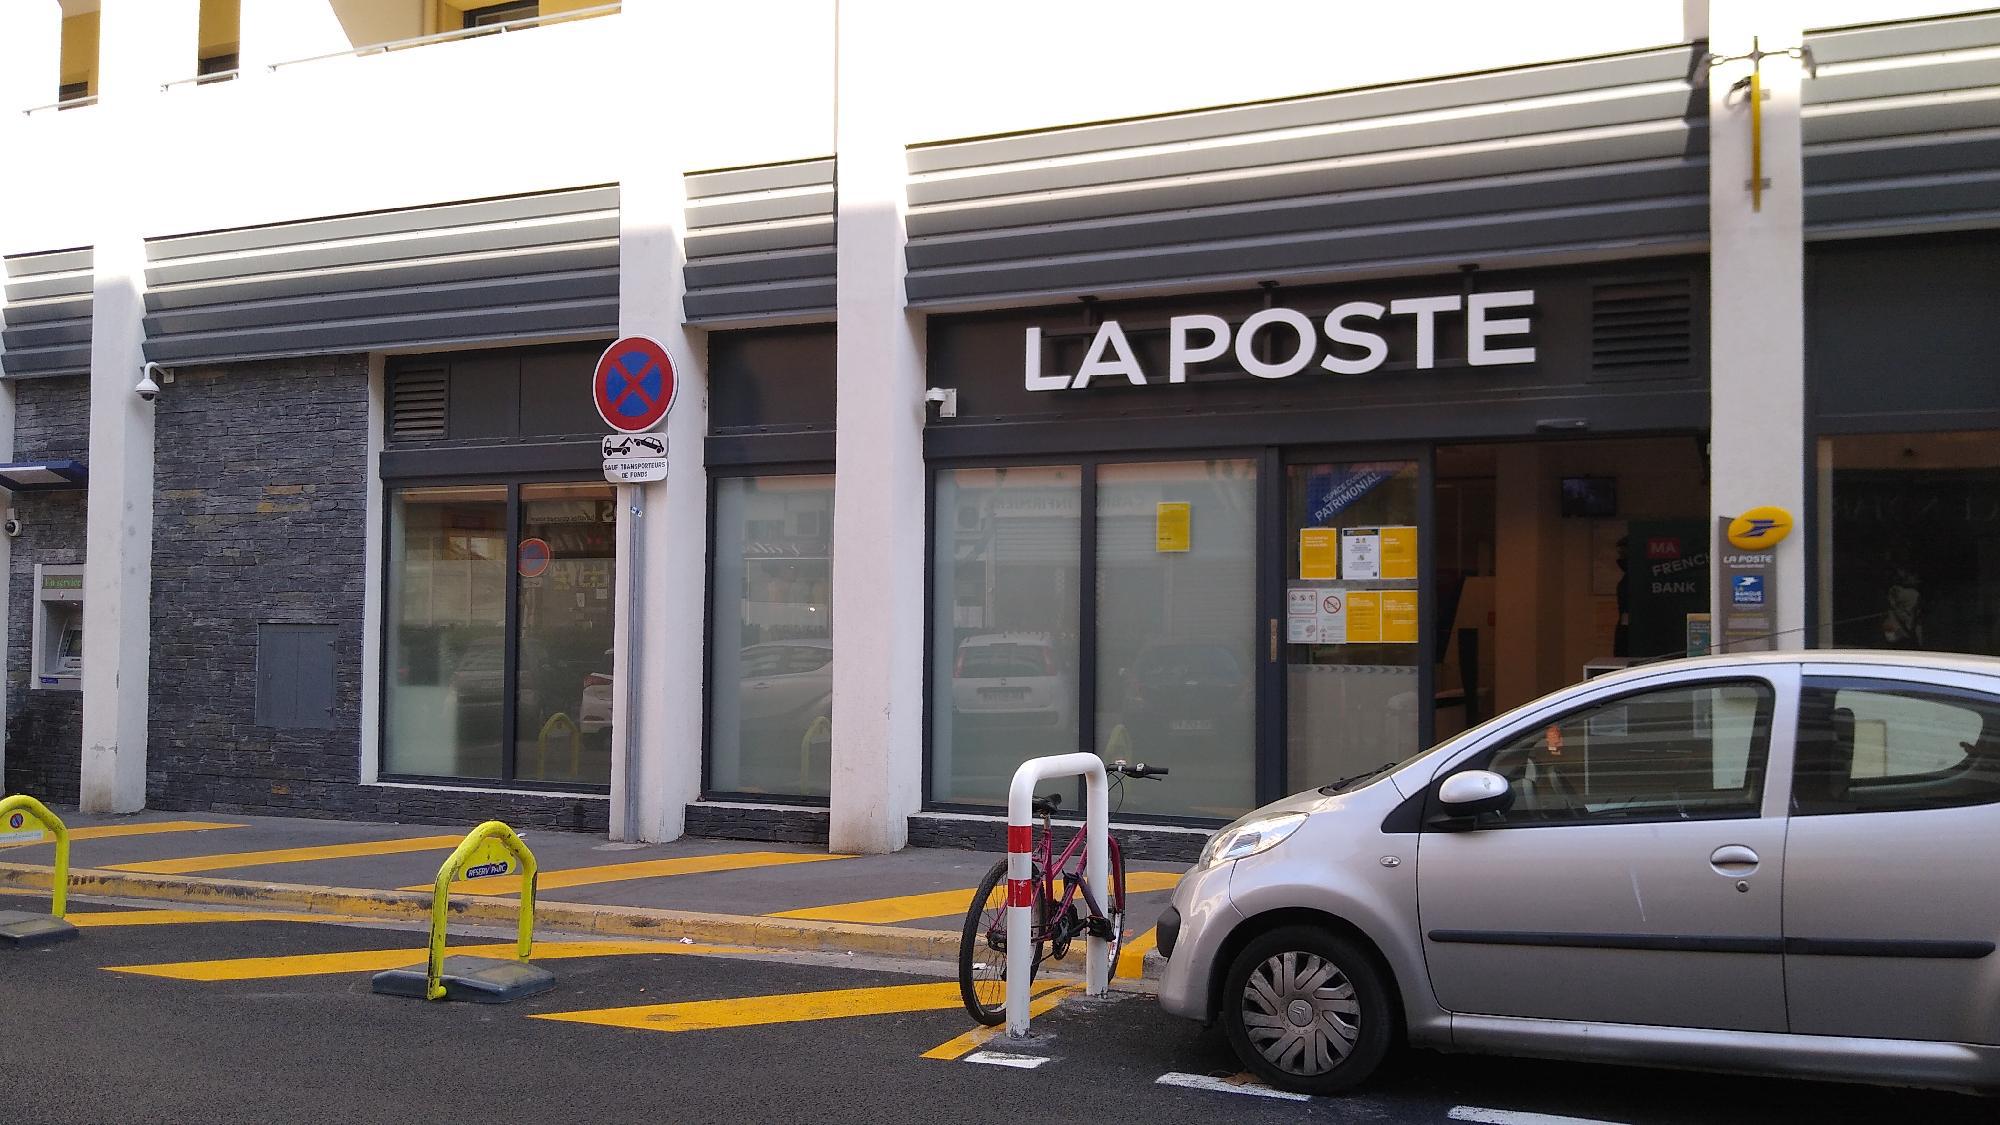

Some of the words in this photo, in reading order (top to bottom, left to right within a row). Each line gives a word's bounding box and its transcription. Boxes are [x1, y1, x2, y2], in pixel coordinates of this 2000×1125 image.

[1025, 320, 1147, 391] LA
[1169, 289, 1536, 384] POSTE
[620, 461, 665, 470] TRANSPORTEURS
[1314, 471, 1381, 521] PATRIMONIAL
[1322, 483, 1347, 503] ESPACE
[1651, 541, 1676, 553] MA
[1652, 582, 1696, 593] BANK
